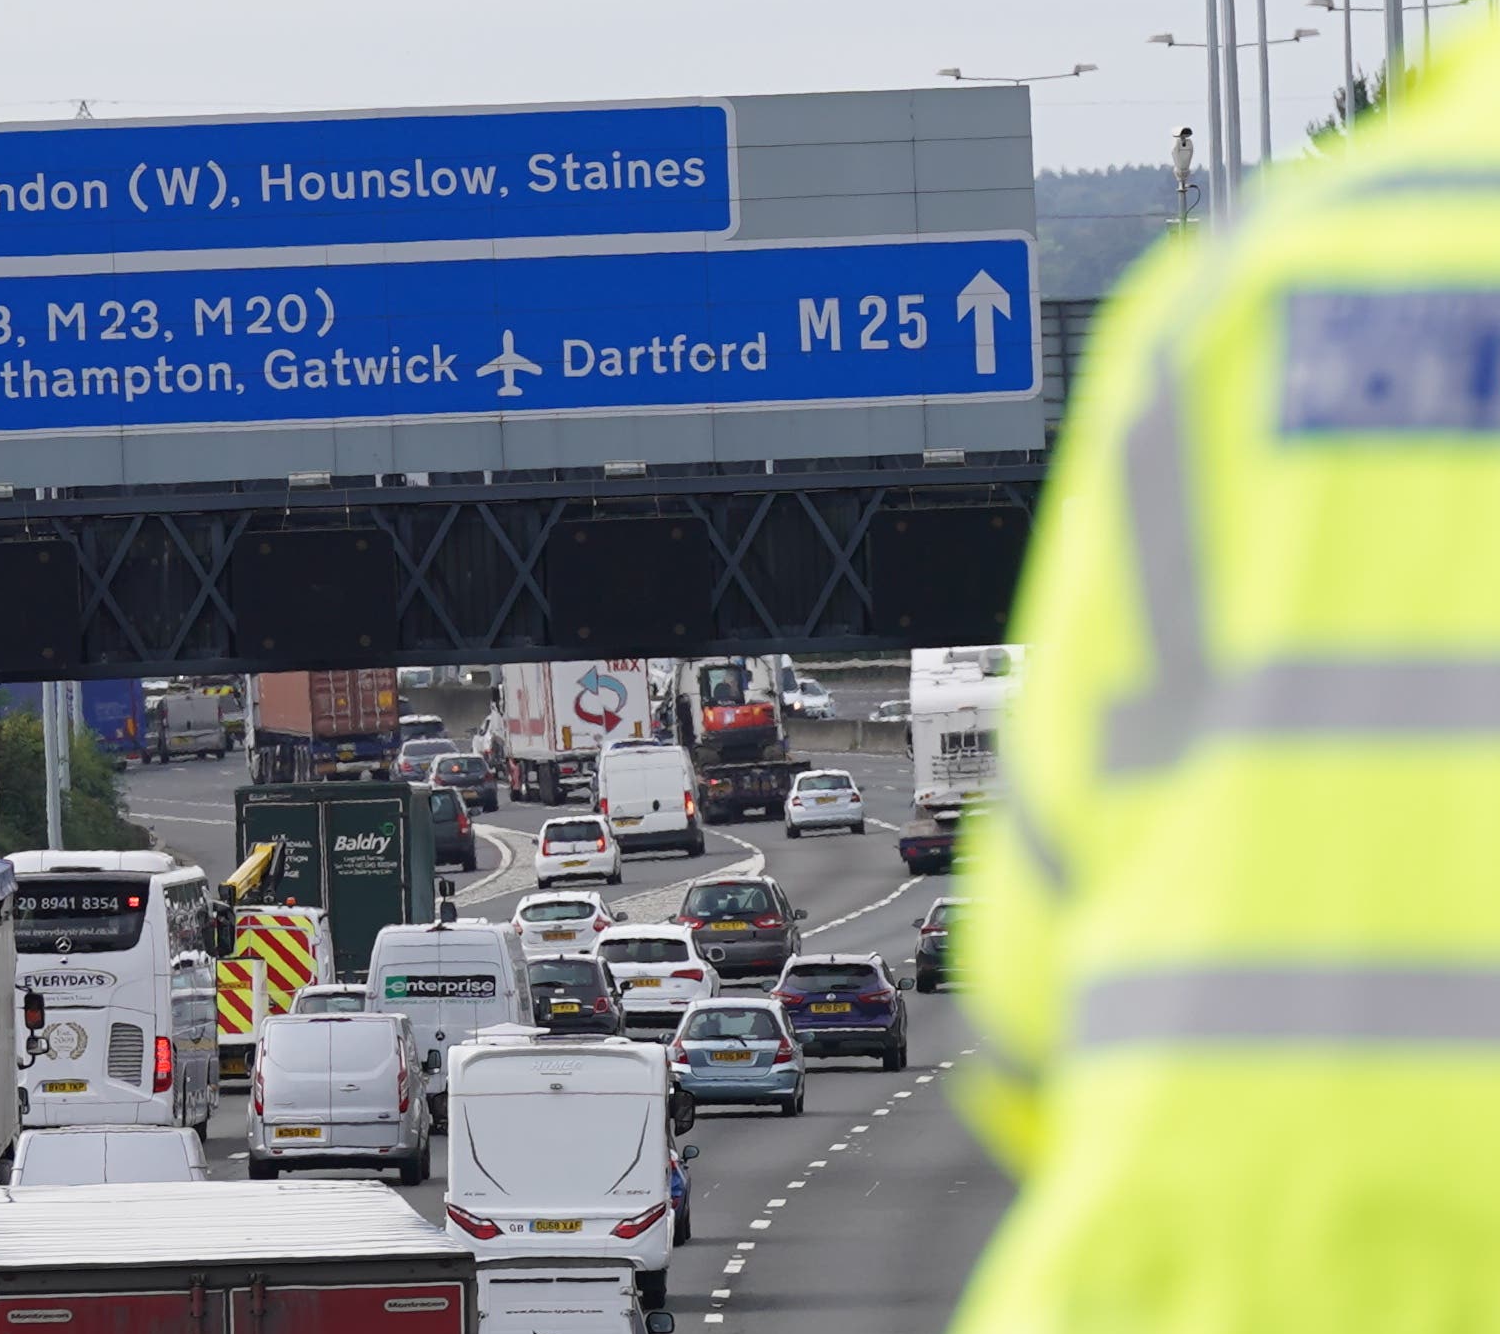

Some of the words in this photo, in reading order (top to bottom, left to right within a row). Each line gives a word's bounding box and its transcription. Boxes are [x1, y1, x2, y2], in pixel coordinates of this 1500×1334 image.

[129, 160, 241, 213] (W),
[260, 158, 509, 202] Hounslow,
[526, 150, 706, 193] Staines
[799, 293, 929, 353] M25
[263, 343, 458, 390] Gatwick
[562, 331, 768, 378] Dartford
[334, 832, 392, 855] Baldry
[41, 896, 76, 910] 8941
[82, 896, 120, 910] 8354
[23, 974, 106, 987] EVERYDAYS
[385, 978, 495, 995] enterprise
